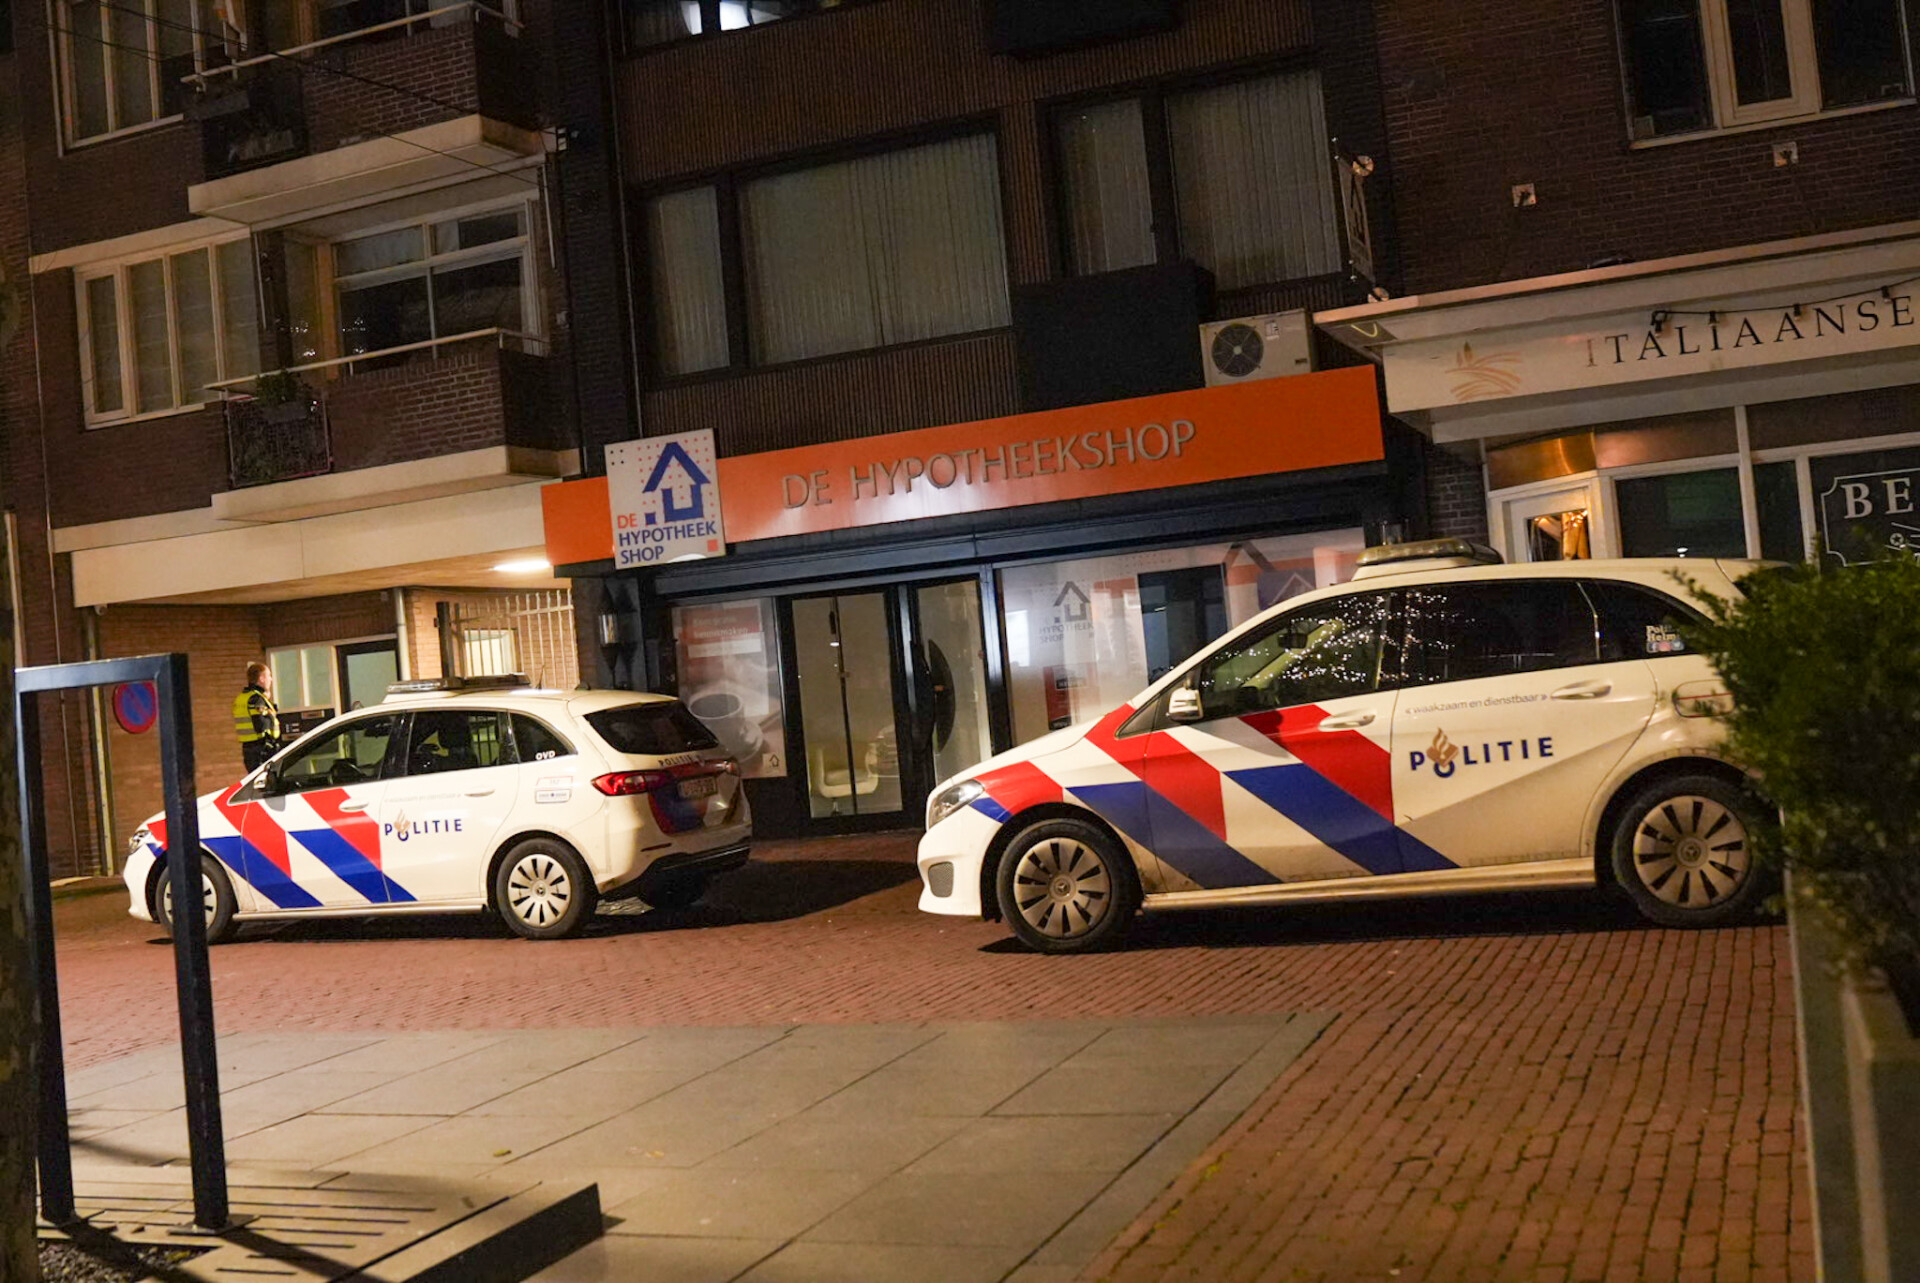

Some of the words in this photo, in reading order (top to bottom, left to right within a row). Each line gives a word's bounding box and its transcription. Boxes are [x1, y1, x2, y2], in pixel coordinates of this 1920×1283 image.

[1587, 295, 1915, 368] ITALIAANSE
[781, 470, 833, 509] DE
[850, 420, 1196, 500] HYPOTHEEKSHOP
[1840, 477, 1914, 519] BE
[617, 513, 638, 529] DE
[618, 521, 717, 547] HYPOTHEEK
[620, 545, 664, 564] SHOP
[1483, 693, 1538, 707] dienstbaar
[1410, 736, 1553, 778] POLITIE
[384, 818, 462, 842] POLITIE
